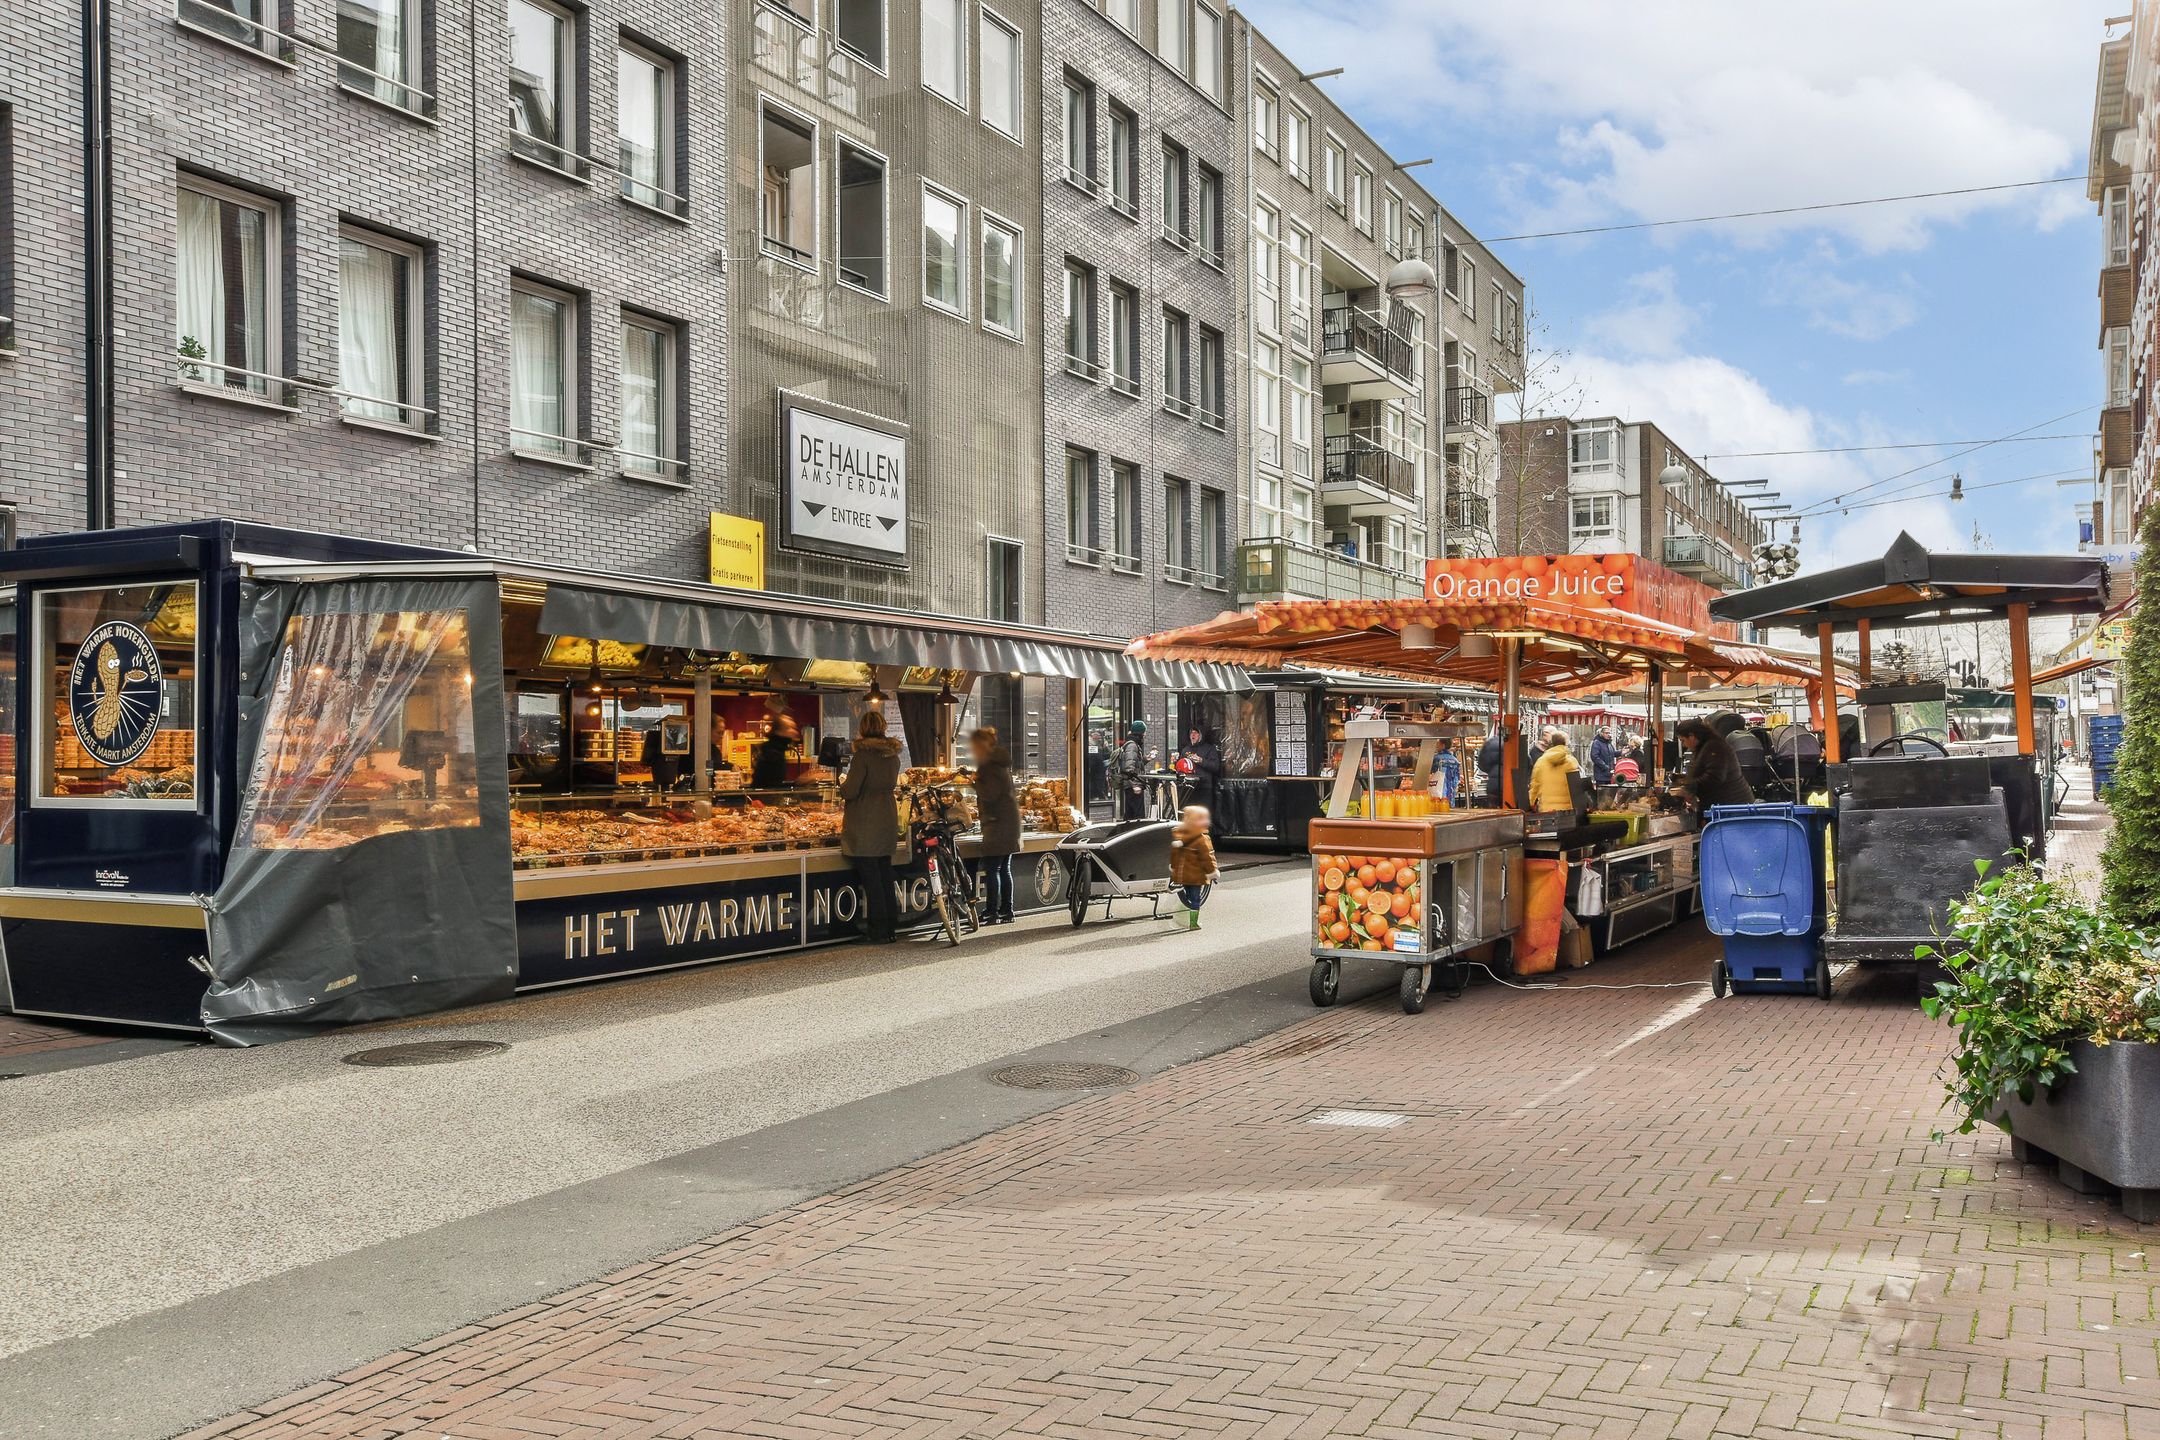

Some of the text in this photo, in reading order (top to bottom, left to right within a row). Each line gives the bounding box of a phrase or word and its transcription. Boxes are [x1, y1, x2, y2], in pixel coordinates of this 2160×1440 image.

[800, 434, 899, 485] DE HALLEN
[801, 465, 899, 500] AMSTERDAM
[831, 506, 872, 529] ENTREE
[712, 533, 752, 554] Fietsenstalling
[712, 566, 754, 584] Gratis parkeren
[1432, 569, 1625, 599] Orange Juice
[1647, 574, 1667, 612] Fresh
[1668, 583, 1685, 617] Fruit
[1685, 589, 1691, 618] &
[73, 625, 160, 686] HET WARME NOTENGILDE
[95, 745, 121, 760] MARKT
[121, 712, 158, 760] AMSTERDAM
[564, 908, 640, 960] HET
[657, 892, 793, 946] WARME
